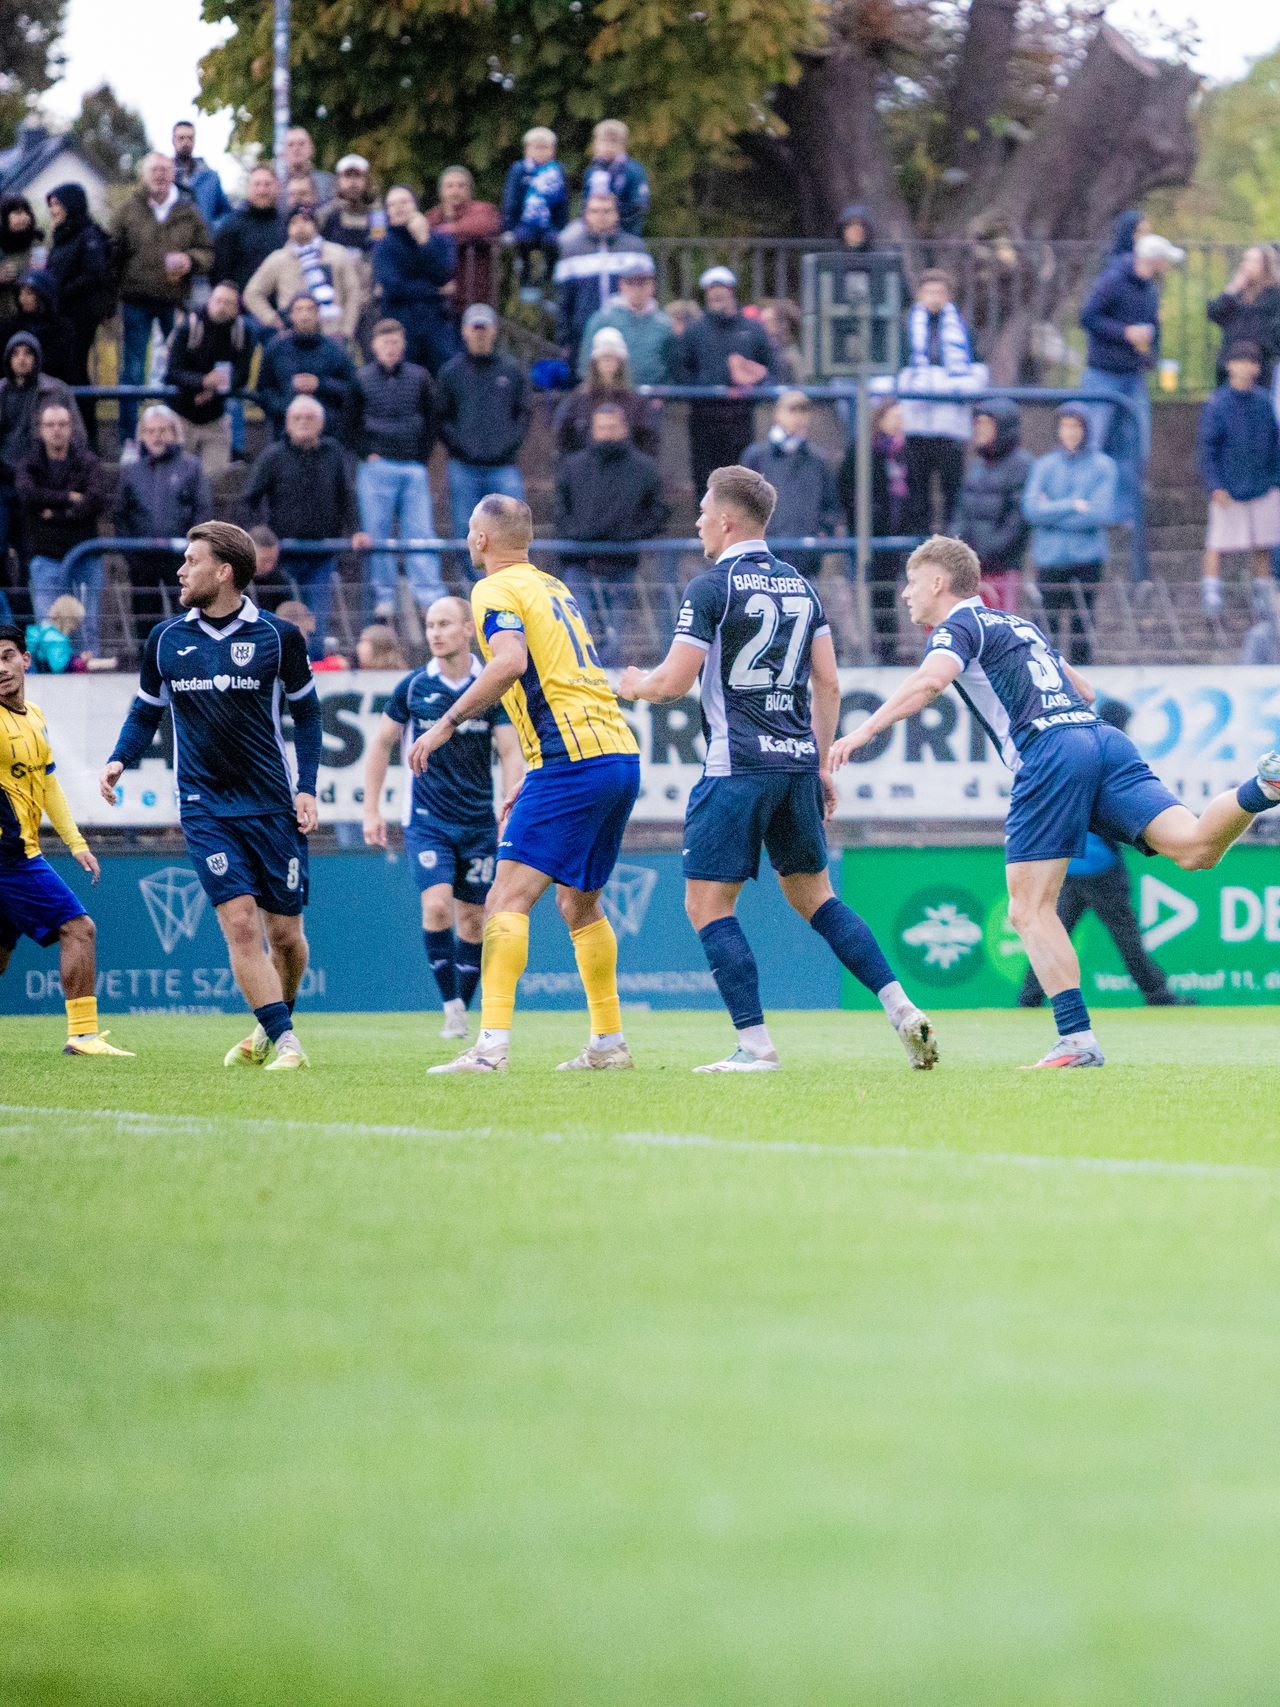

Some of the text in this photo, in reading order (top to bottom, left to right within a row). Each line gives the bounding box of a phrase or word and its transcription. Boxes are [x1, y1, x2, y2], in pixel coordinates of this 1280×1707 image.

[728, 593, 814, 690] 27
[1010, 625, 1063, 692] 3
[170, 676, 261, 693] Potsdam Liebe
[765, 691, 794, 712] BÜCH
[1031, 711, 1097, 731] Katjes
[758, 735, 816, 758] Katjes
[286, 857, 300, 890] 8
[94, 968, 183, 999] VETTE
[192, 967, 326, 998] SZDI
